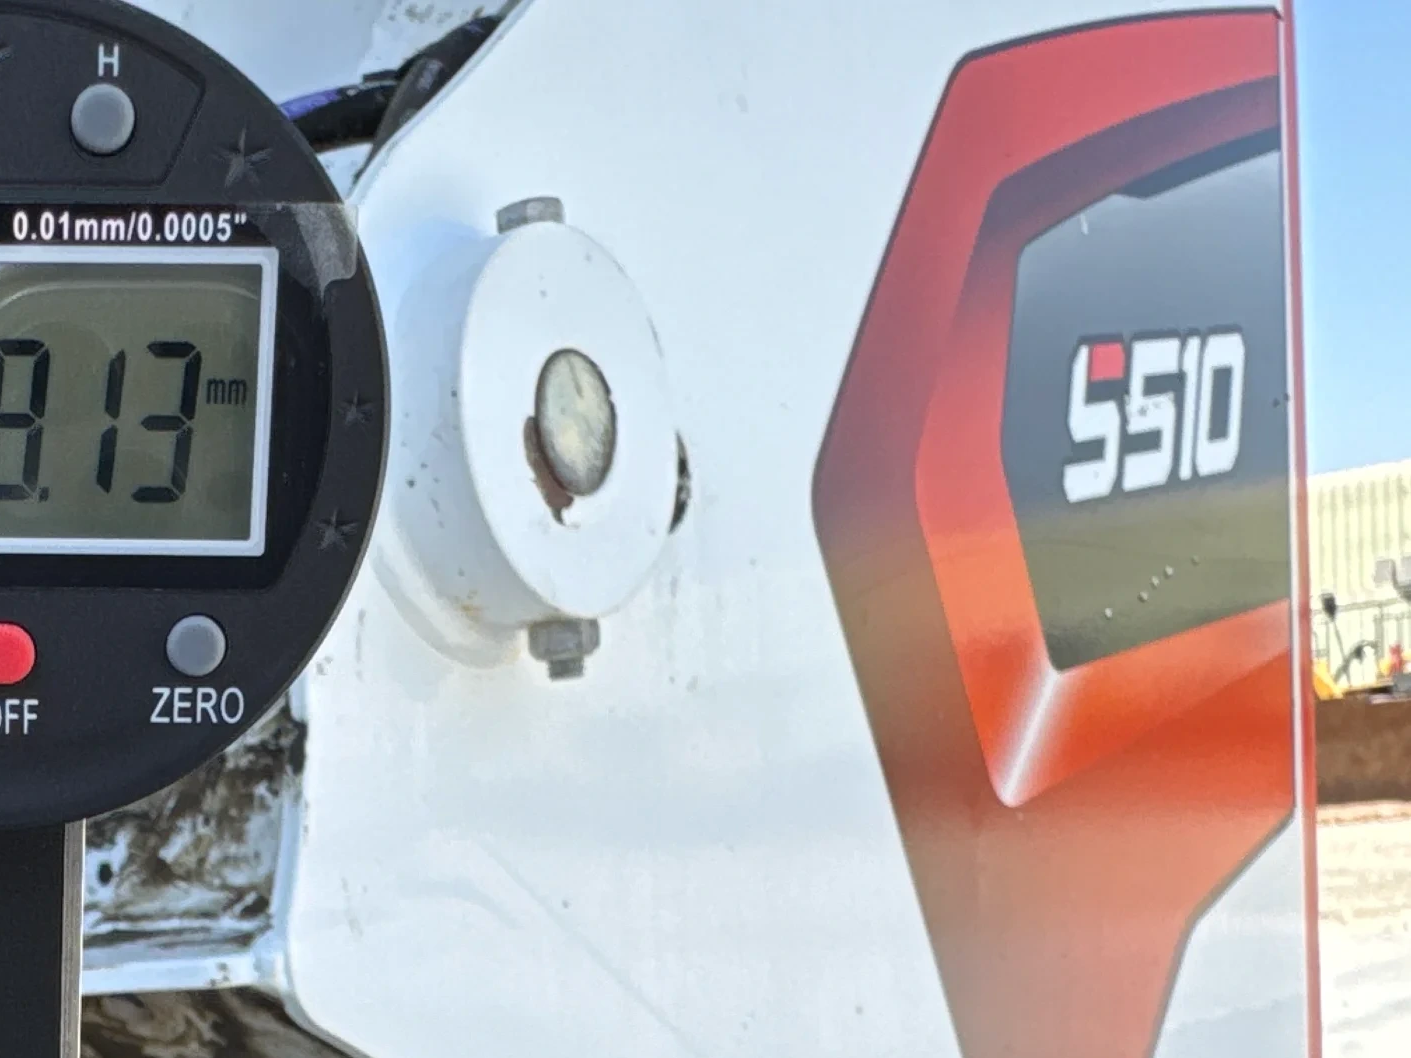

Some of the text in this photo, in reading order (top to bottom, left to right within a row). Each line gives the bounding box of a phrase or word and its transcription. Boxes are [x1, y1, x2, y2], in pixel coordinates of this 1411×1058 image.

[98, 44, 119, 77] H
[12, 211, 247, 243] 0.01mm/0.0005"
[205, 374, 248, 408] mm
[1062, 330, 1245, 504] S510
[150, 687, 245, 725] ZERO
